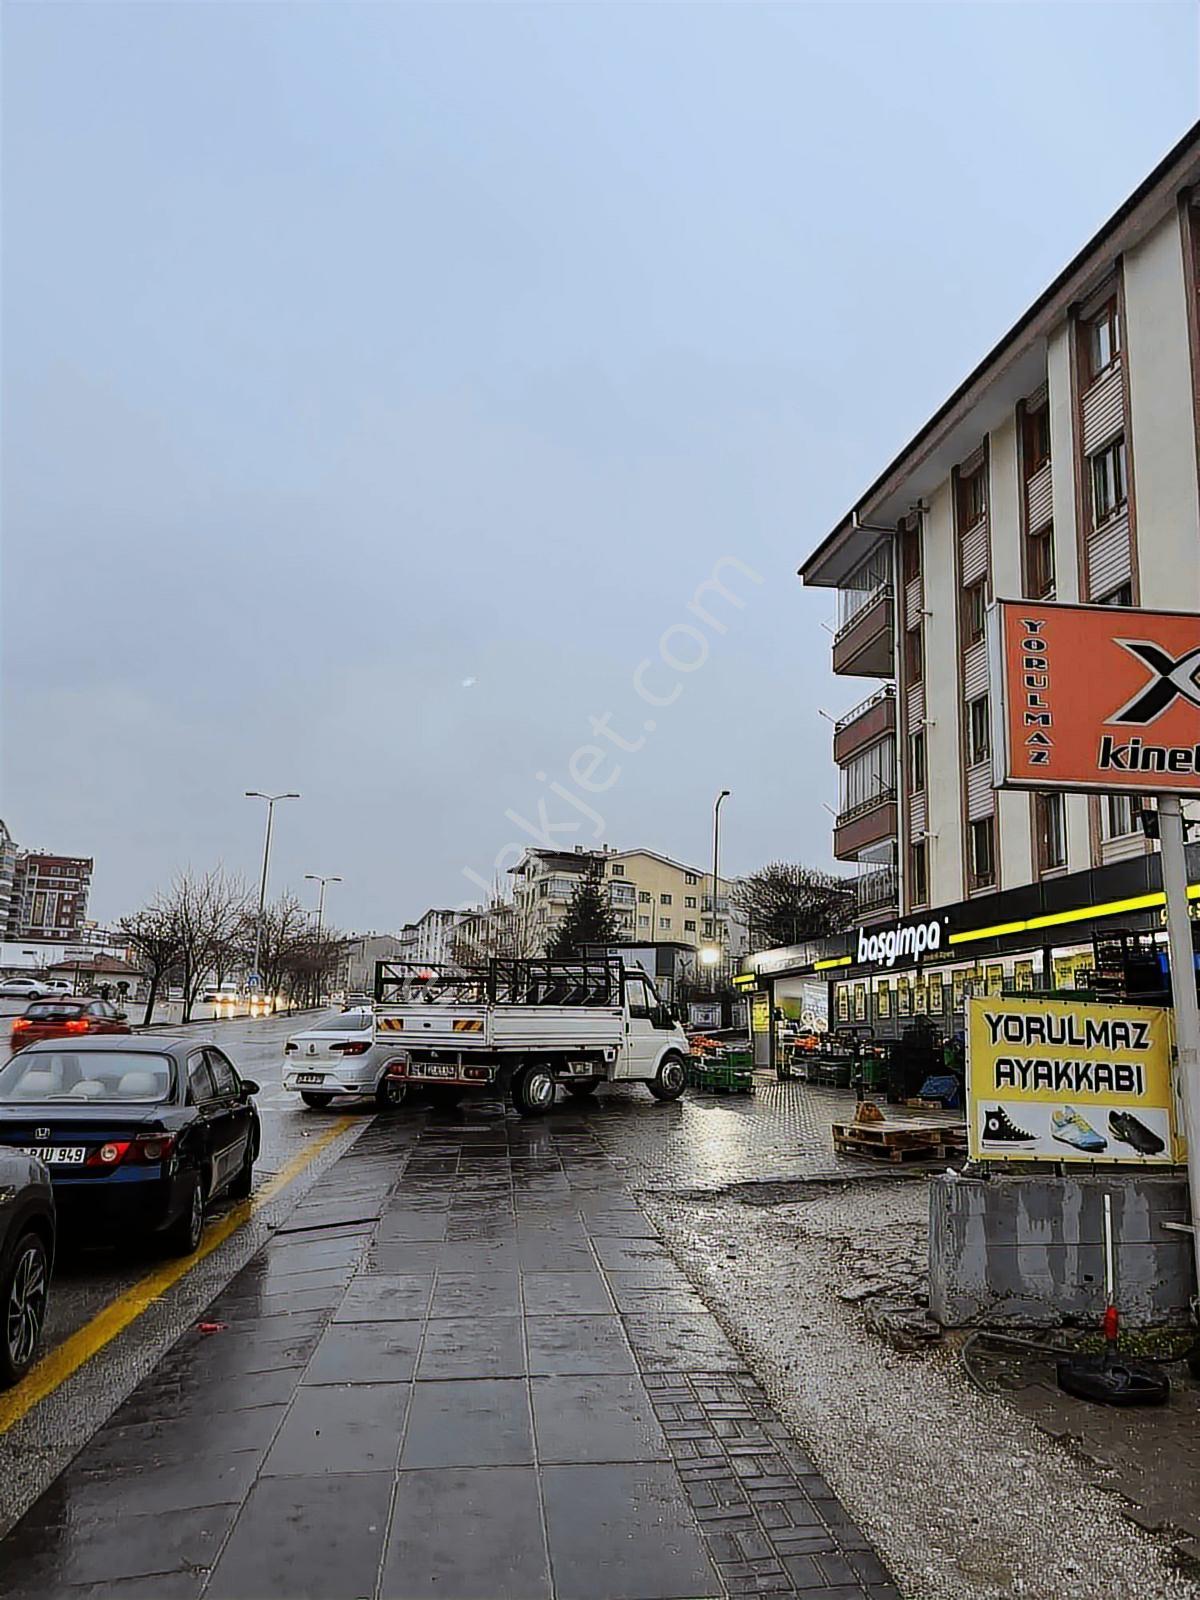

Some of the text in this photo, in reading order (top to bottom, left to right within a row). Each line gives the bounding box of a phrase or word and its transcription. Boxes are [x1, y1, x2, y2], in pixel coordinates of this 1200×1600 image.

[1018, 619, 1054, 765] YORULMAZ
[983, 1012, 1153, 1051] YORULMAZ
[994, 1057, 1145, 1097] AYAKKABI
[58, 1148, 83, 1162] 949
